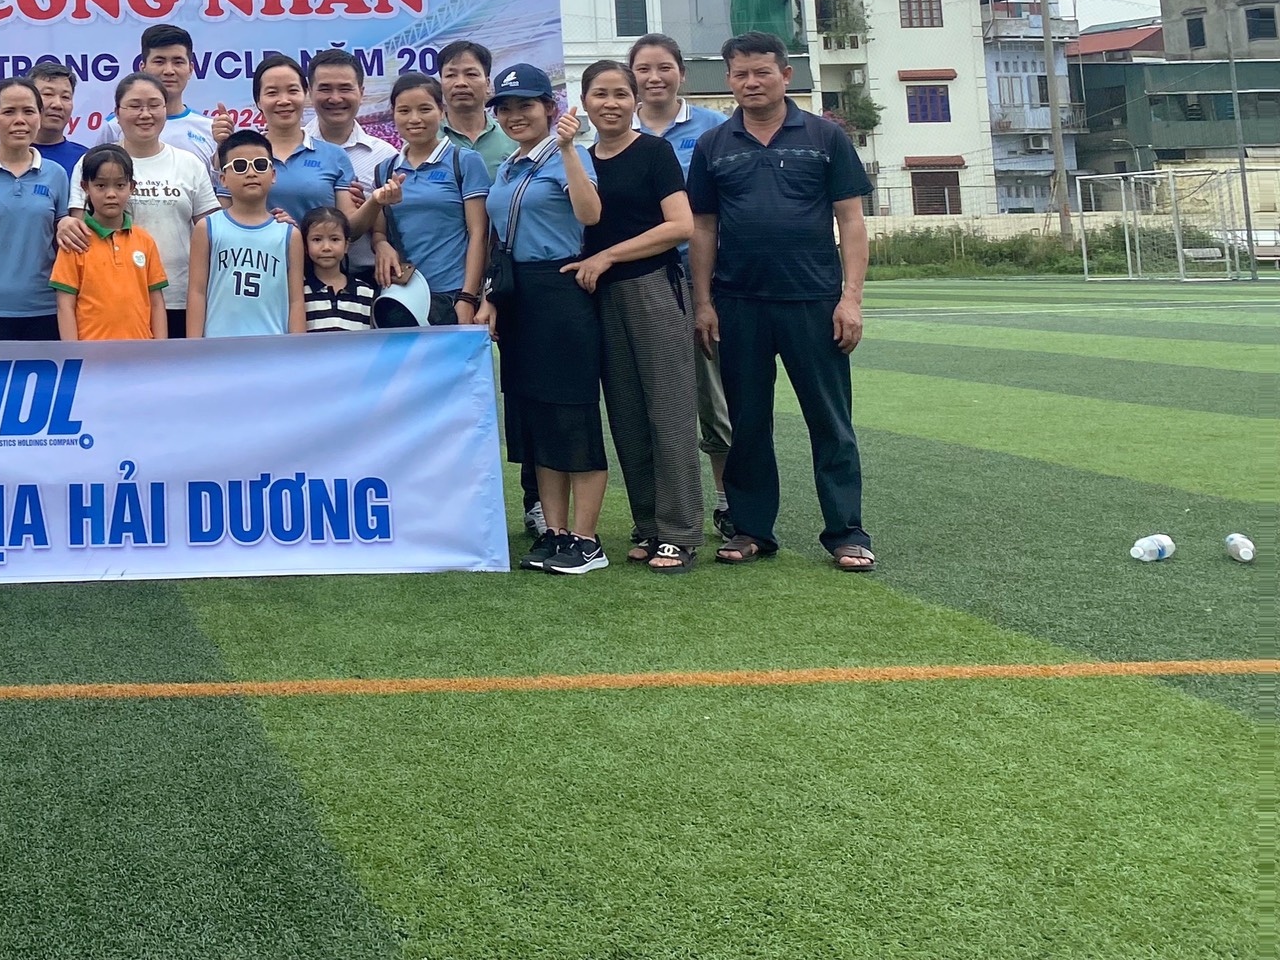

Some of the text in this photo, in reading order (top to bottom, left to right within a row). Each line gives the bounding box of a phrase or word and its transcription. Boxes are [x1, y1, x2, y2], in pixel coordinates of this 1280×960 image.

[300, 42, 384, 78] NM
[131, 186, 181, 197] ant to
[218, 247, 281, 278] RYANT
[233, 271, 261, 298] 15
[17, 439, 48, 447] HOLDINGS
[48, 438, 79, 446] COMPANY
[69, 461, 166, 547] HẢI
[187, 472, 392, 543] DƯƠNG
